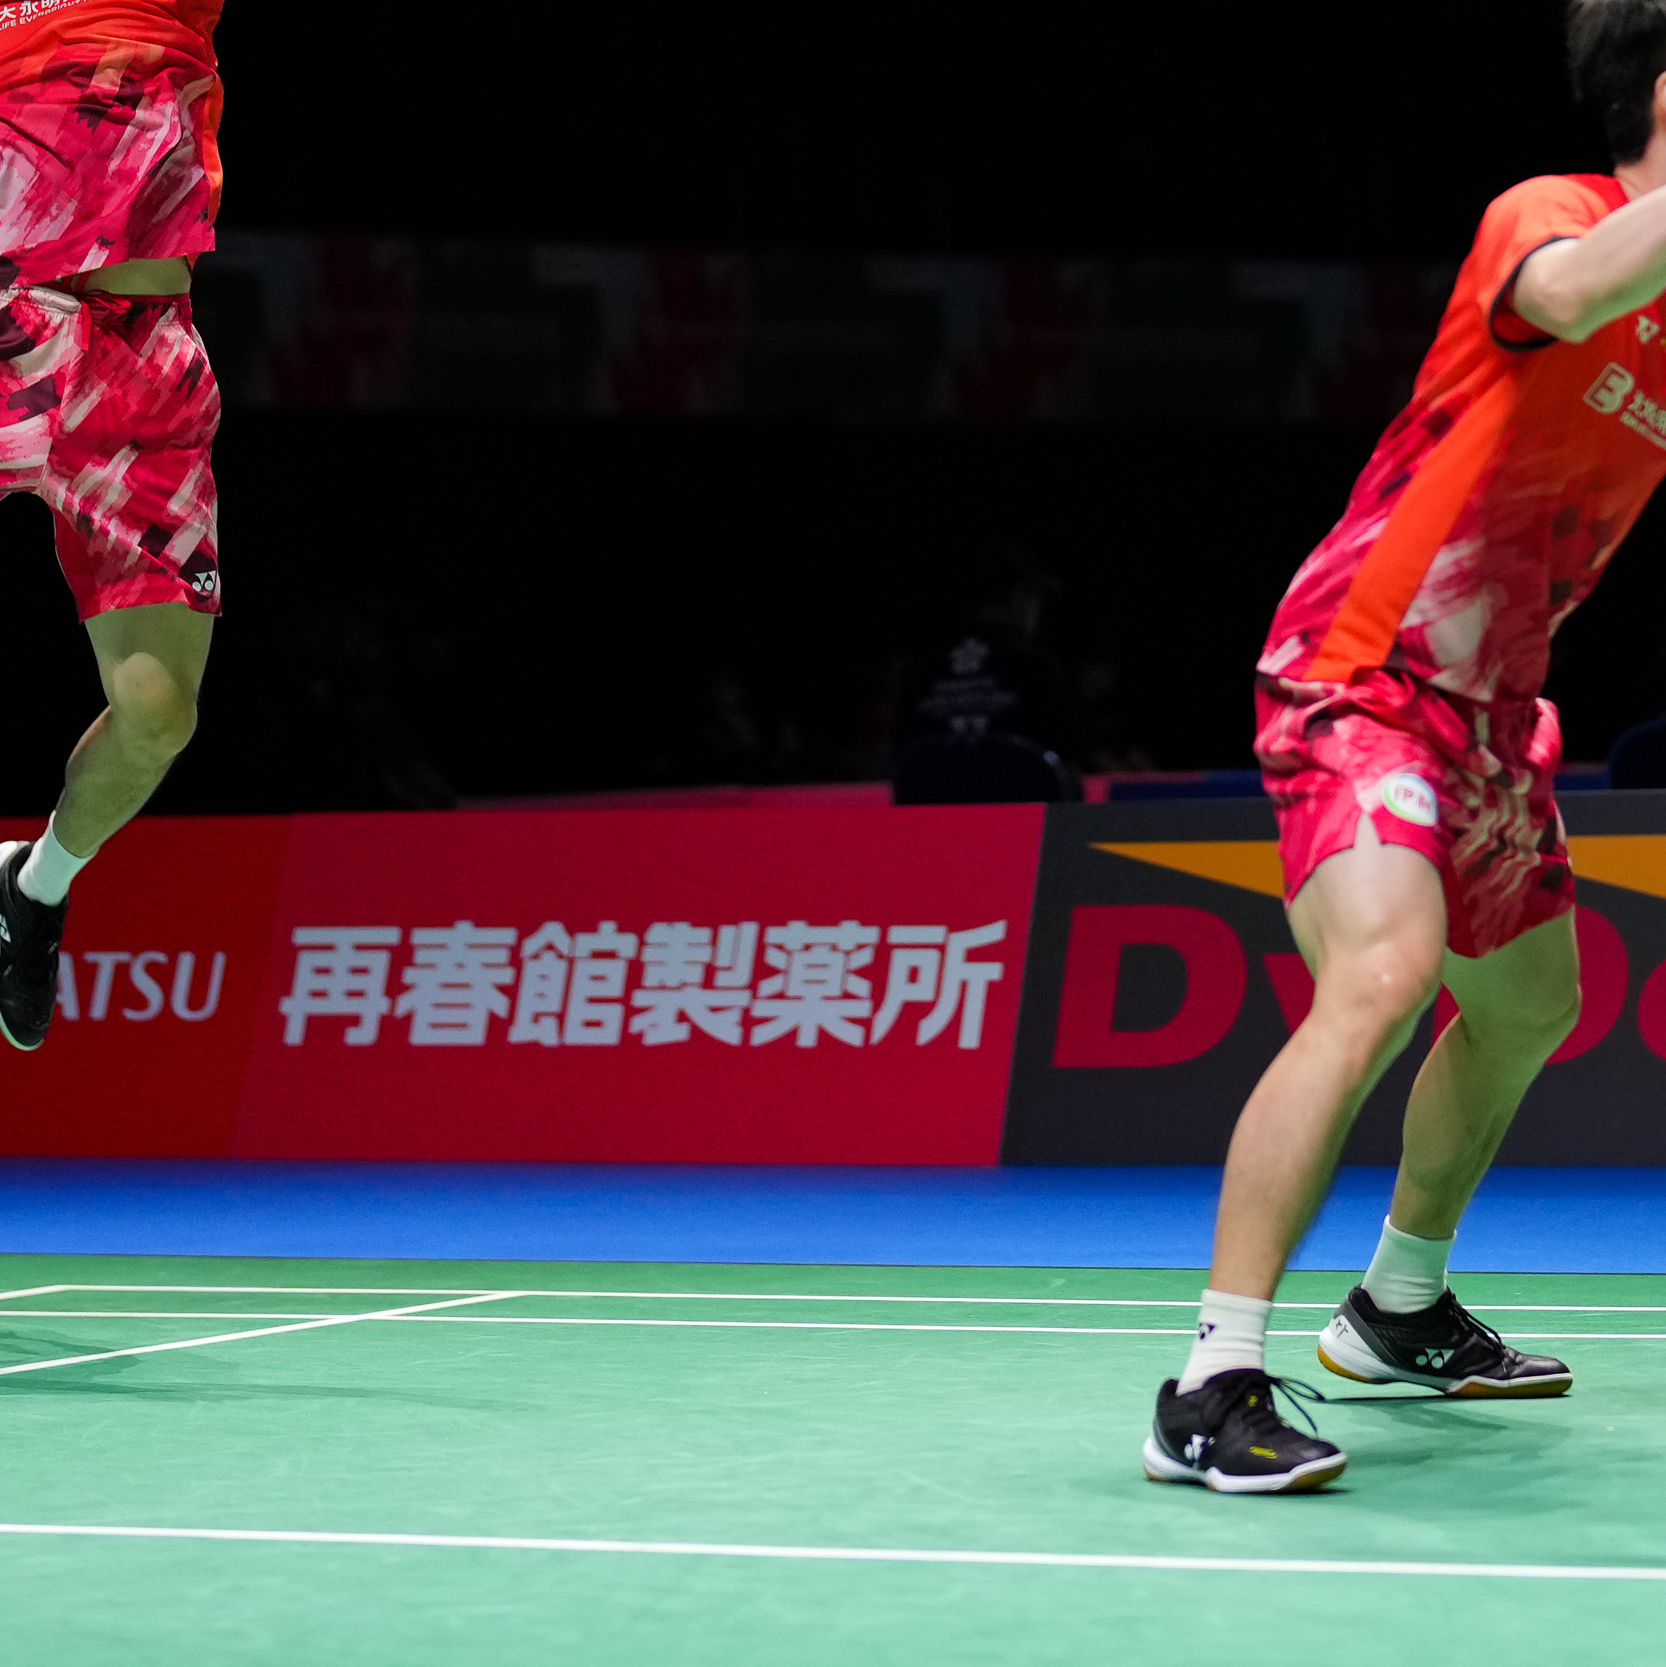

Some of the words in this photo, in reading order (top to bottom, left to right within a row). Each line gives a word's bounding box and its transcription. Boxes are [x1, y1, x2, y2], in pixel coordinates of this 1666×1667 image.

[279, 920, 1007, 1050] 再春館製薬所
